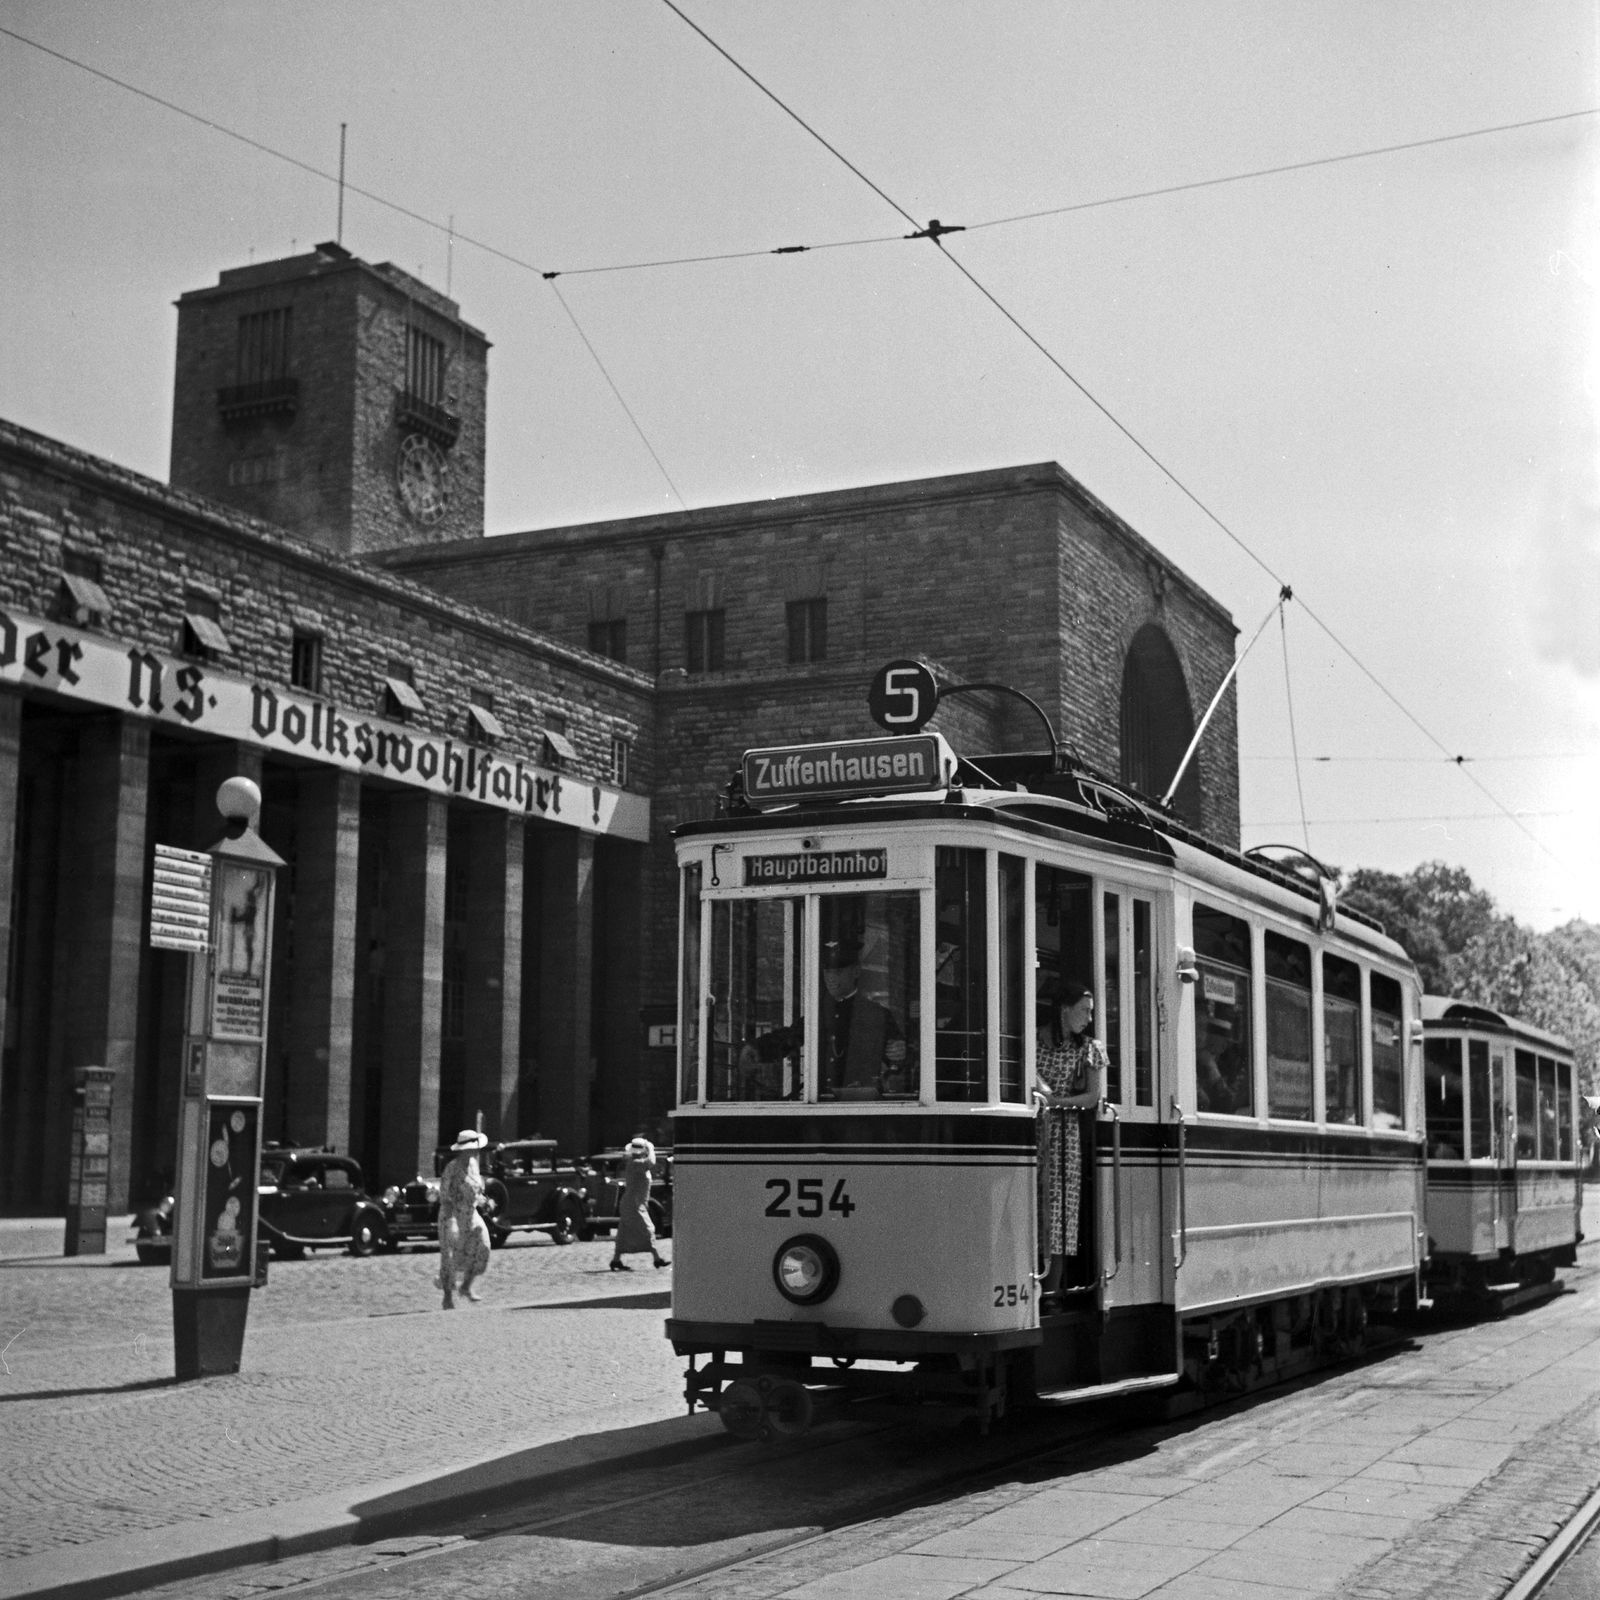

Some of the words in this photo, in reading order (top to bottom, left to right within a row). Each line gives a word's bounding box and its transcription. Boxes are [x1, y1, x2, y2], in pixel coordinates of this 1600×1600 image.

[884, 668, 920, 723] 5
[251, 683, 563, 815] Volkswohlfahrt
[755, 751, 925, 790] Zuffenhausen
[751, 850, 887, 880] Hauptbahnhof
[764, 1178, 856, 1218] 254
[993, 1284, 1030, 1308] 254
